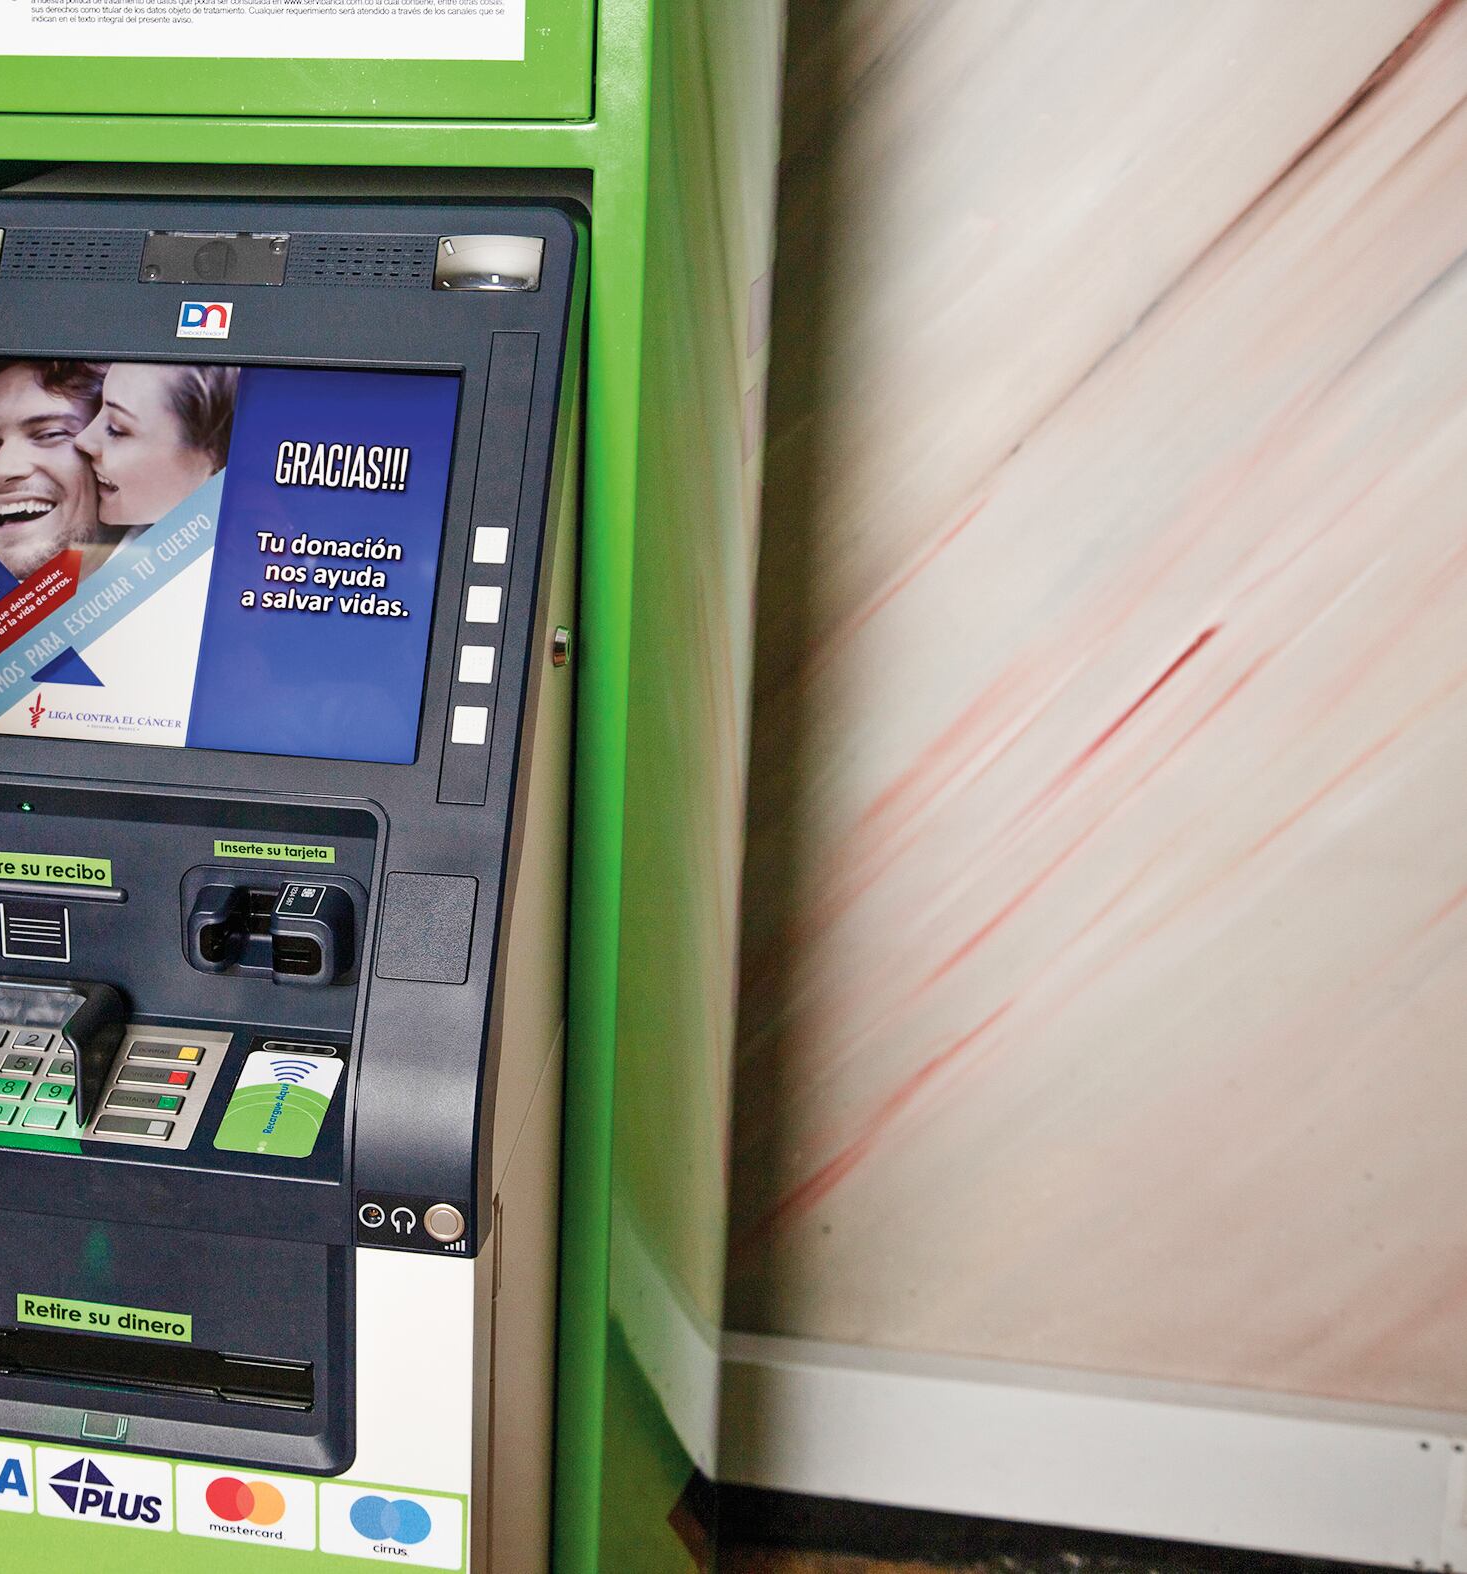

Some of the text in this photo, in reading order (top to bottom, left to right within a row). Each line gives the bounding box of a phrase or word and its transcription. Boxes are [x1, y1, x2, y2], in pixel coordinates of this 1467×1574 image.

[31, 14, 57, 23] indican
[70, 14, 77, 23] el
[78, 14, 96, 23] texto
[97, 14, 124, 25] integral
[125, 14, 137, 23] del
[138, 15, 170, 25] presente
[45, 5, 79, 14] derechos
[102, 5, 122, 14] titular
[123, 5, 133, 14] de
[134, 5, 145, 14] los
[146, 5, 167, 14] datos
[168, 5, 191, 16] objeto
[192, 6, 202, 14] de
[248, 6, 284, 16] Cualquier
[286, 6, 337, 16] requerimiento
[357, 6, 390, 15] atendido
[423, 6, 433, 15] de
[434, 7, 445, 15] los
[447, 7, 477, 15] canales
[479, 9, 494, 17] que
[275, 441, 410, 491] GRACIAS!!!
[257, 531, 402, 560] Tu donación
[10, 591, 35, 612] debes
[35, 568, 64, 592] cuidar.
[265, 564, 386, 589] nos ayuda
[8, 617, 18, 628] la
[17, 603, 36, 621] vida
[36, 593, 48, 606] de
[48, 576, 73, 596] otros.
[24, 631, 65, 668] PARA
[63, 576, 134, 637] ESCUCHAR
[131, 558, 156, 581] TU
[156, 513, 212, 563] CUERPO
[241, 588, 409, 617] a salvar vidas.
[48, 710, 182, 728] LIGA CONTRA EL CÁNCER
[221, 842, 328, 860] Inserte su tarjeta
[21, 864, 41, 877] su
[46, 864, 106, 881] recibo
[24, 1034, 39, 1046] 2
[14, 1057, 74, 1074] 5 6
[2, 1081, 16, 1094] 8
[48, 1085, 62, 1098] 9
[262, 1102, 283, 1134] Recargue
[23, 1299, 187, 1338] Retire su dinero
[78, 1488, 163, 1524] PLUS
